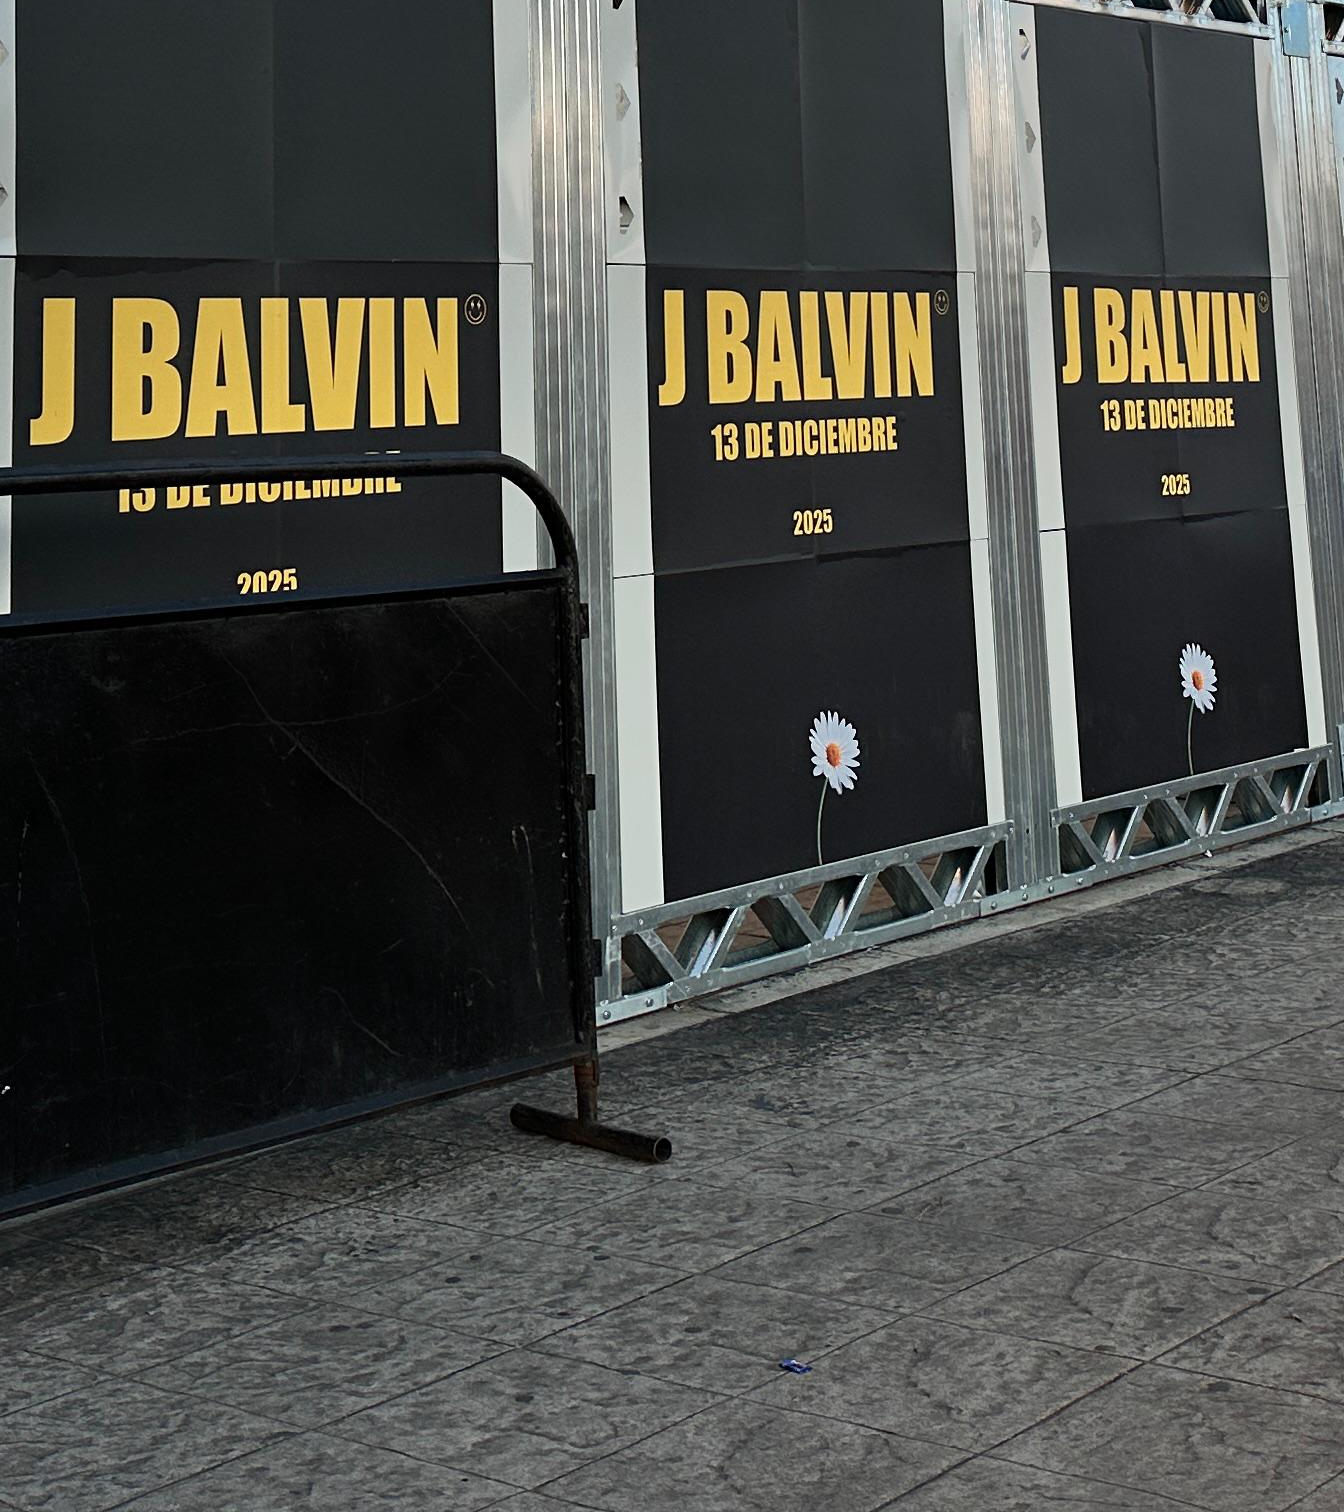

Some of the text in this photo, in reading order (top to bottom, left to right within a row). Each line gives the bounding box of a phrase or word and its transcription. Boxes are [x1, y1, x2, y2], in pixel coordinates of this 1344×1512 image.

[659, 290, 935, 407] J BALVIN
[1063, 287, 1261, 384] J BALVIN
[30, 298, 461, 446] J BALVIN
[1100, 397, 1236, 432] 13 DE DICIEMBRE
[711, 416, 899, 462] 13 DE DICIEMBRE
[1161, 474, 1192, 496] 2025
[793, 508, 834, 537] 2025
[237, 568, 299, 595] 2025
